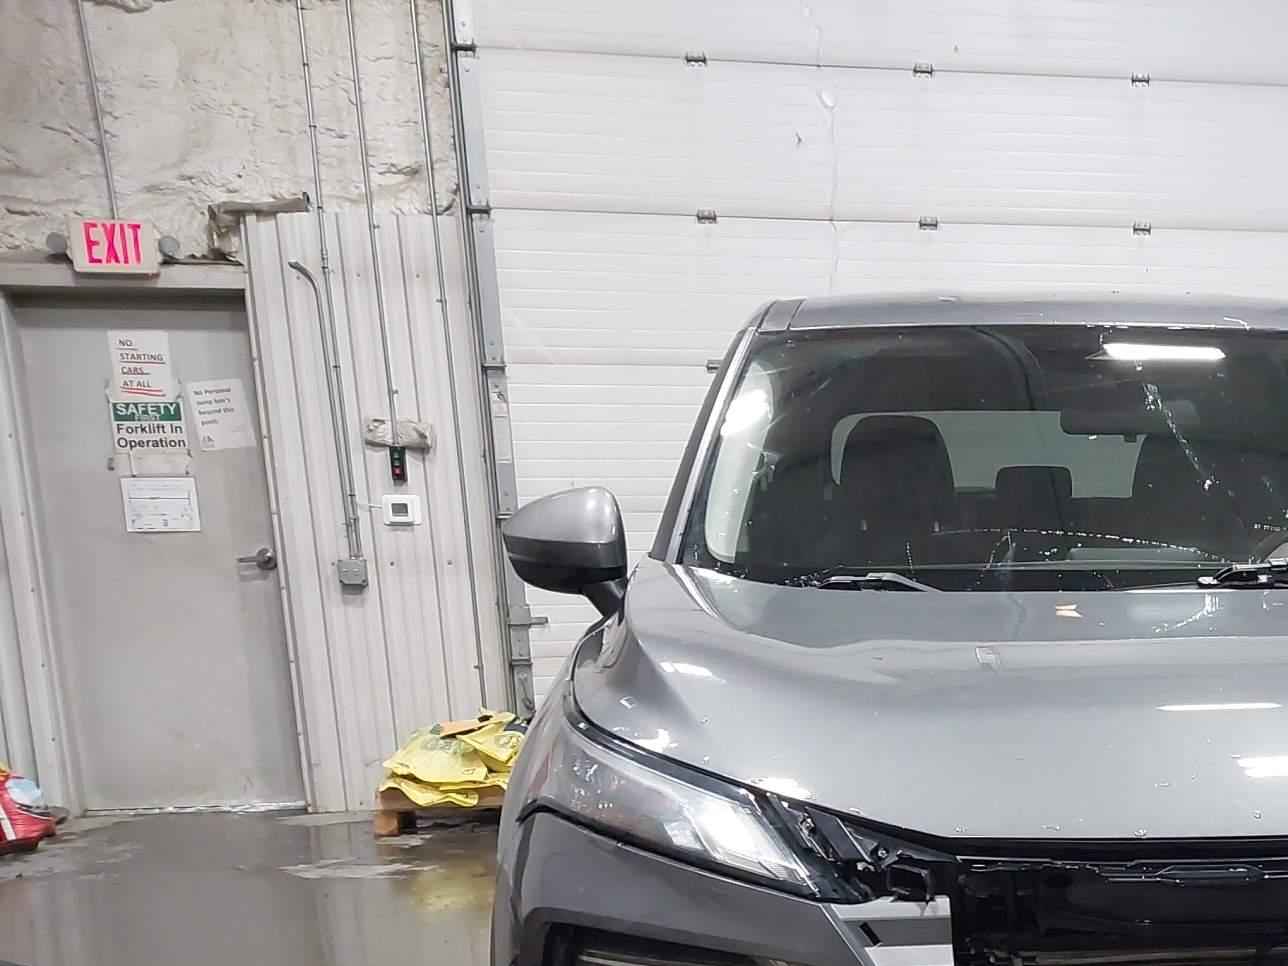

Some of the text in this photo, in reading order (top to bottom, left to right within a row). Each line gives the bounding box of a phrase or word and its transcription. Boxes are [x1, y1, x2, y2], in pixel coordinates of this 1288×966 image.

[83, 222, 141, 264] EXIT
[118, 339, 133, 347] NO
[119, 353, 164, 361] STARTING
[121, 366, 145, 374] CARS
[136, 380, 151, 388] ALL
[116, 403, 176, 415] SAFETY
[116, 423, 183, 434] Forklift In
[117, 437, 187, 451] Operation
